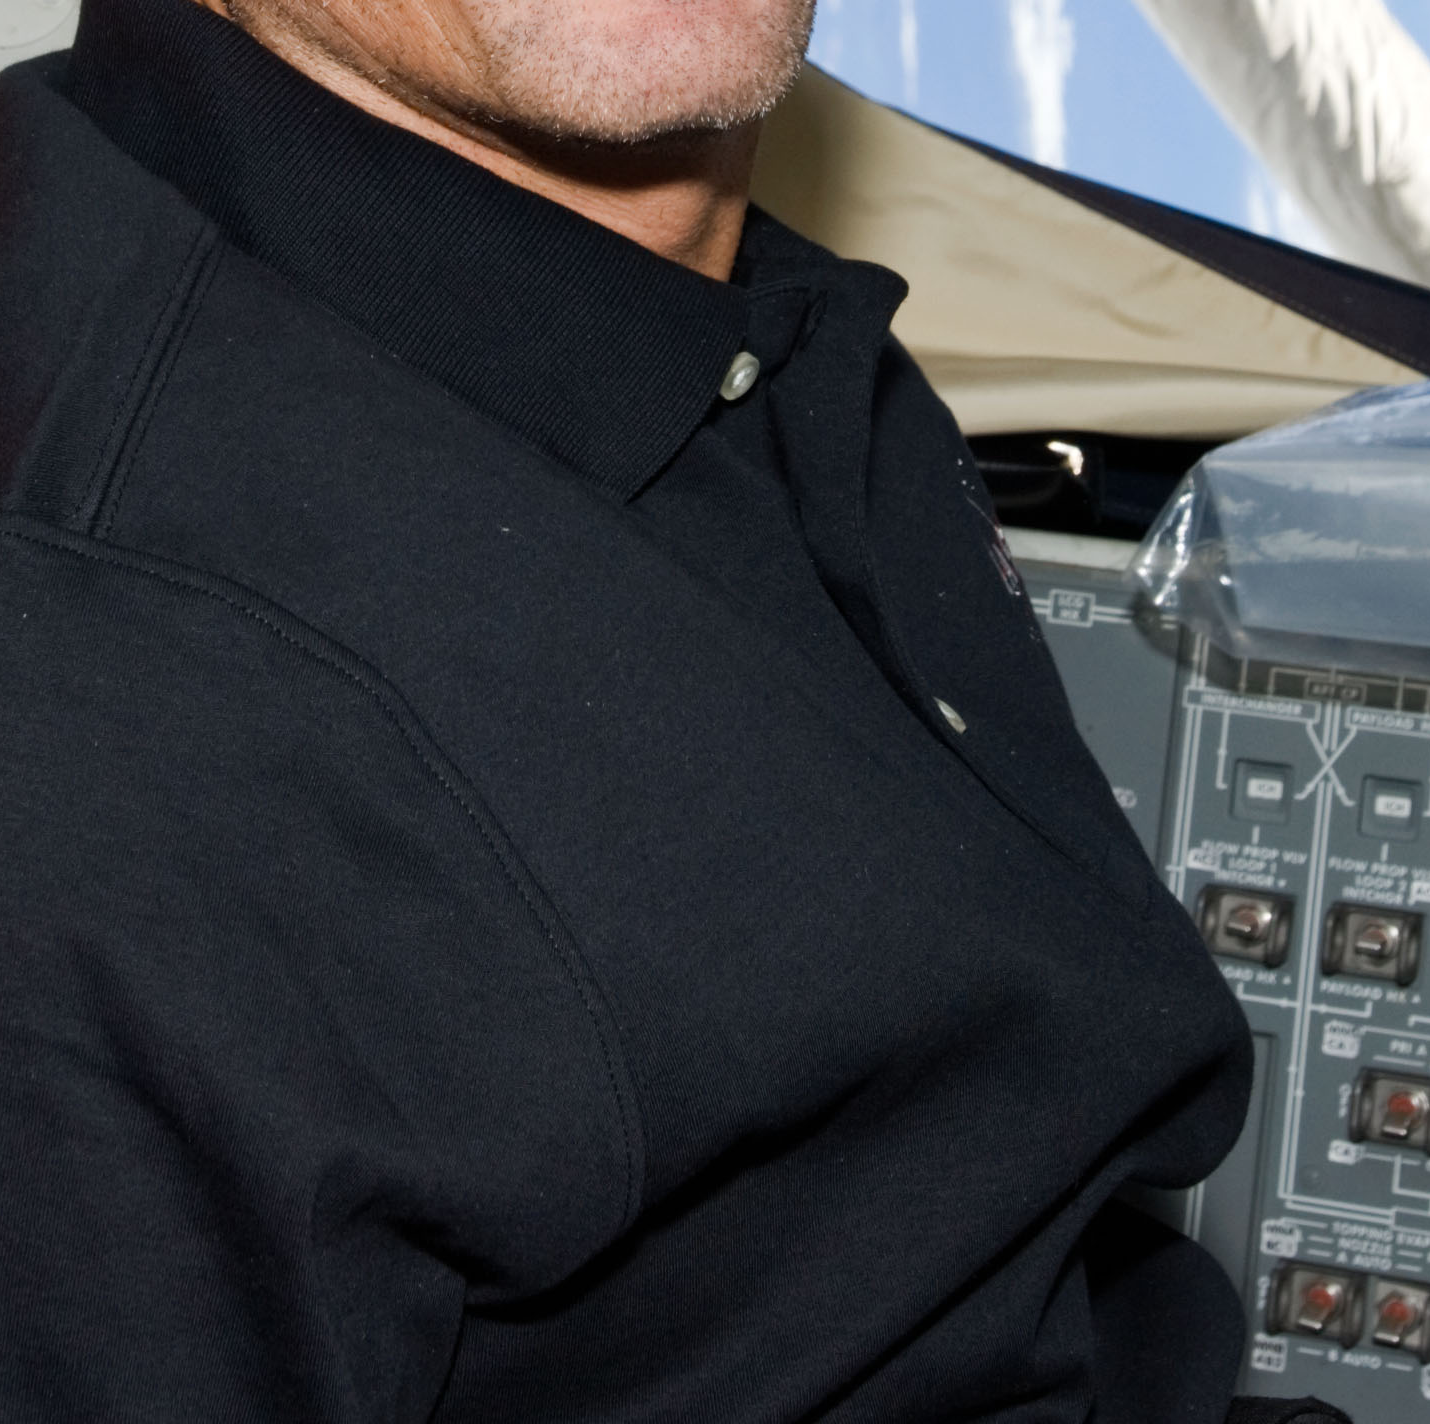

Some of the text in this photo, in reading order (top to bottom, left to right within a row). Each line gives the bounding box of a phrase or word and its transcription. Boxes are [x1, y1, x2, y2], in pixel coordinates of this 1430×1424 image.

[1415, 1044, 1427, 1056] A
[1331, 1222, 1393, 1242] TOPPING
[1336, 1252, 1392, 1270] A AUTO
[1341, 1352, 1382, 1368] AUTO
